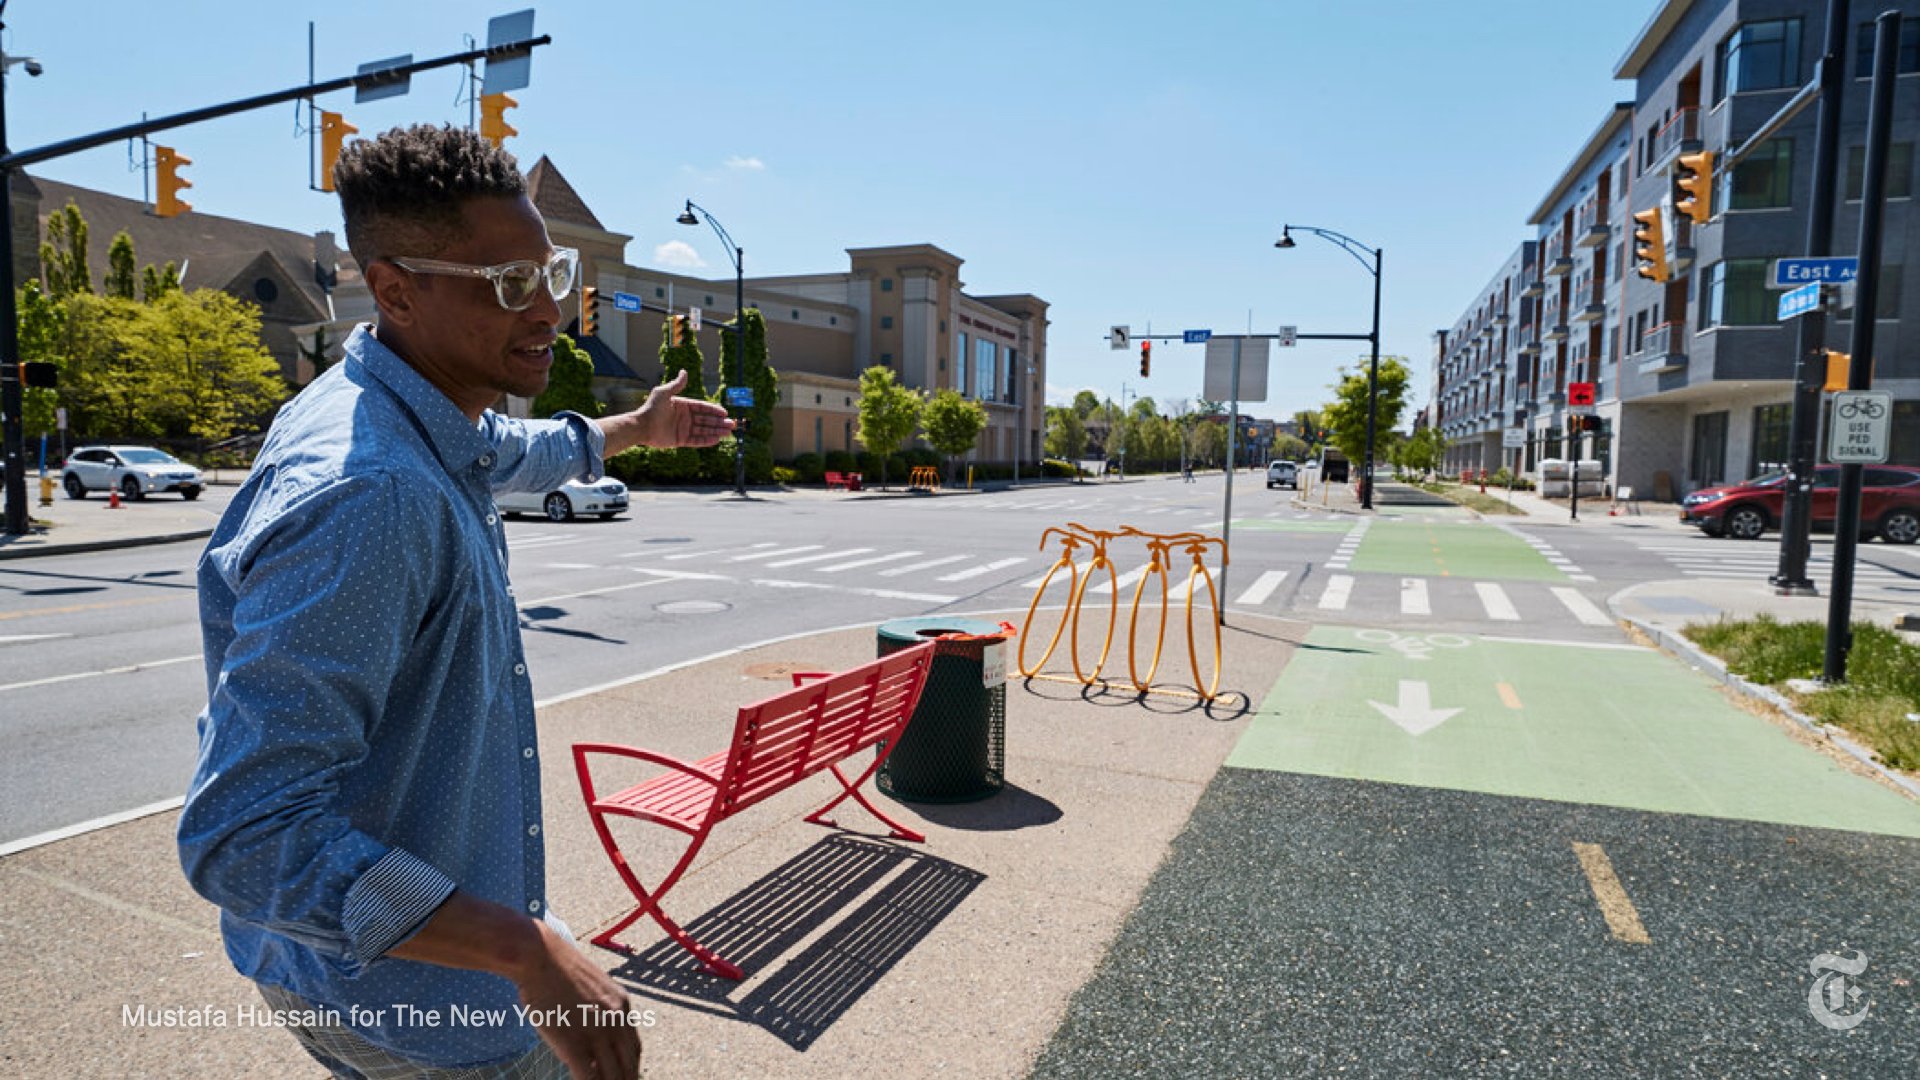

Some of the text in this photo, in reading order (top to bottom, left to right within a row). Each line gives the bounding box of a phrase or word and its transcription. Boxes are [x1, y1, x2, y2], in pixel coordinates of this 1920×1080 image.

[1787, 264, 1831, 280] East
[1848, 422, 1871, 433] USE
[1848, 434, 1871, 444] PED
[1838, 446, 1878, 457] SIGNAL
